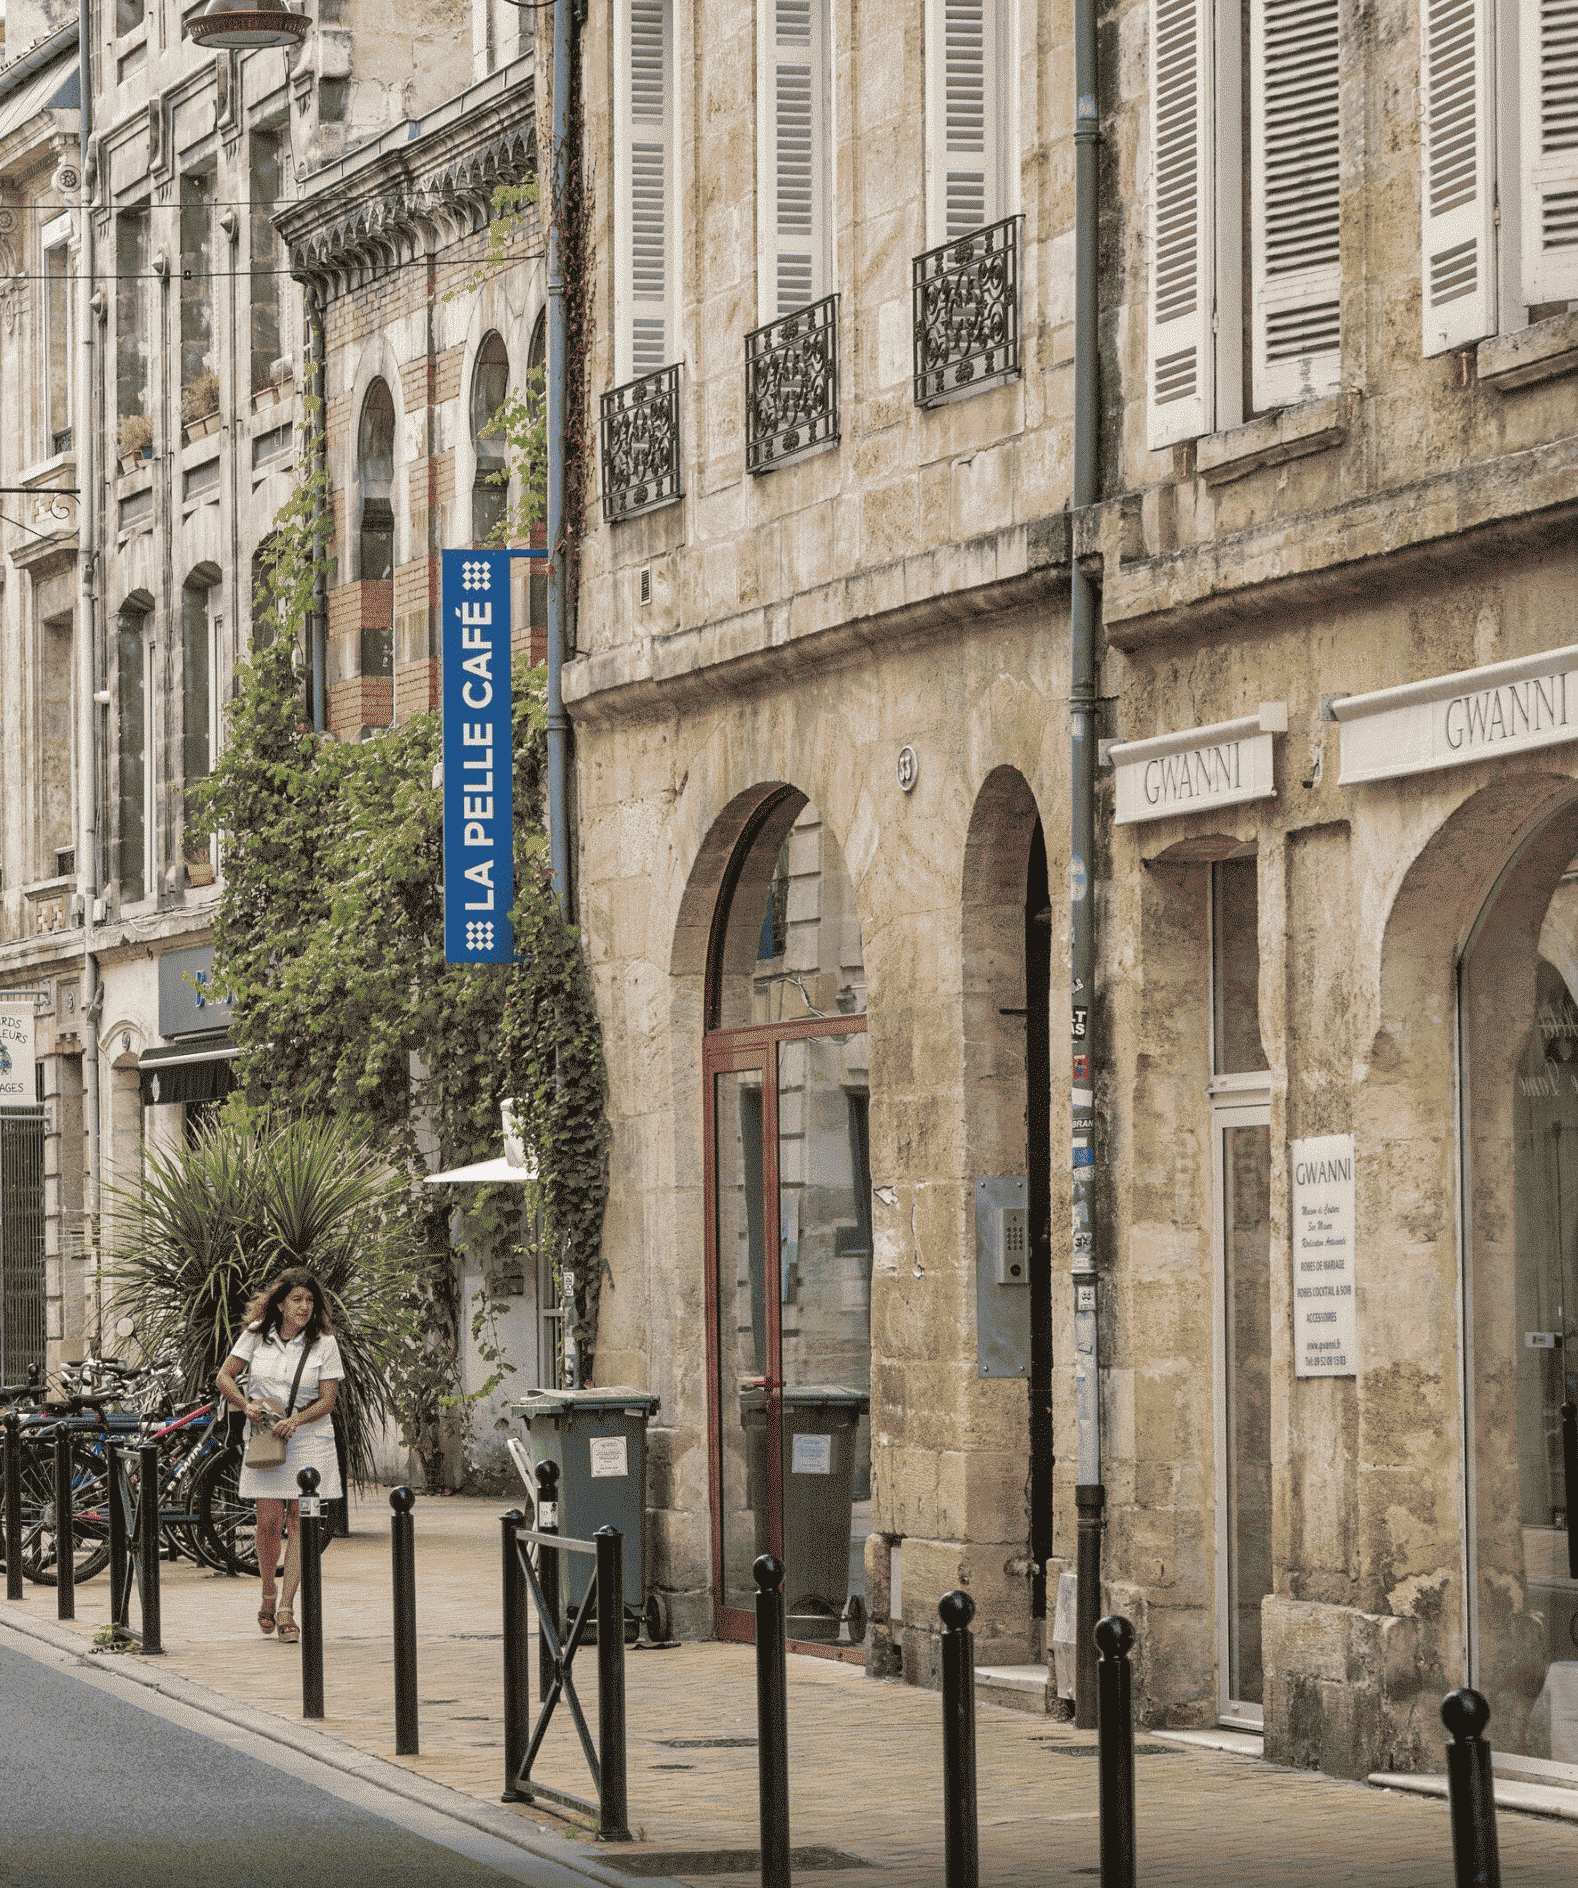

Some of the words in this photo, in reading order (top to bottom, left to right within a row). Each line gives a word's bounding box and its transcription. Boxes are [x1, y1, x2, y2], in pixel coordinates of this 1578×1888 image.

[455, 600, 493, 710] CAFÉ
[1445, 672, 1568, 750] GWANNI
[462, 722, 494, 847] PELLE
[1144, 741, 1241, 805] GWANNI
[464, 859, 495, 911] LA
[1295, 1158, 1352, 1186] GWANNI
[1300, 1260, 1316, 1272] ROBES
[1316, 1260, 1323, 1271] DE
[1323, 1259, 1345, 1270] MARIAGE
[1297, 1287, 1312, 1298] ROBES
[1312, 1286, 1335, 1297] COCKTAIL
[1340, 1285, 1352, 1296] SOIR
[1306, 1312, 1337, 1324] ACCESSOIRES
[1307, 1338, 1341, 1353] www.gwanni.fr
